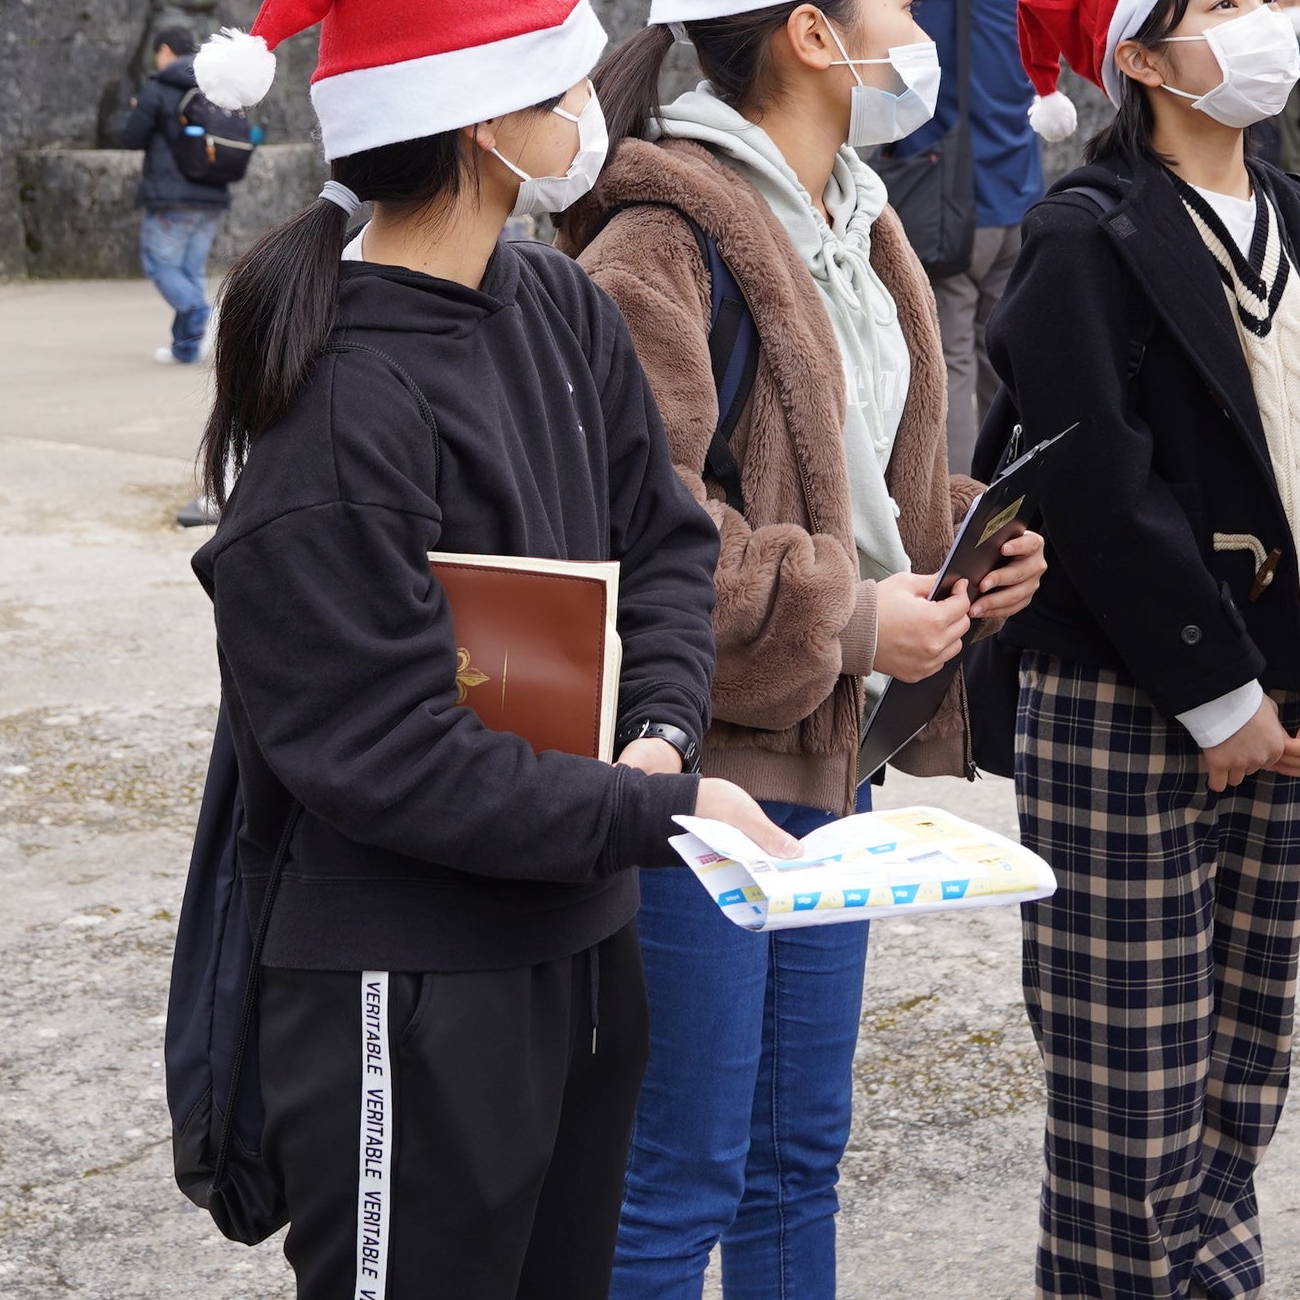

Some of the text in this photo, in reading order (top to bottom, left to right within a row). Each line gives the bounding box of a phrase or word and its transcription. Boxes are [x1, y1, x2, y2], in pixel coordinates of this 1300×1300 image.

[366, 982, 383, 1076] VERITABLE
[365, 1089, 384, 1180] VERITABLE
[361, 1191, 382, 1280] VERITABLE
